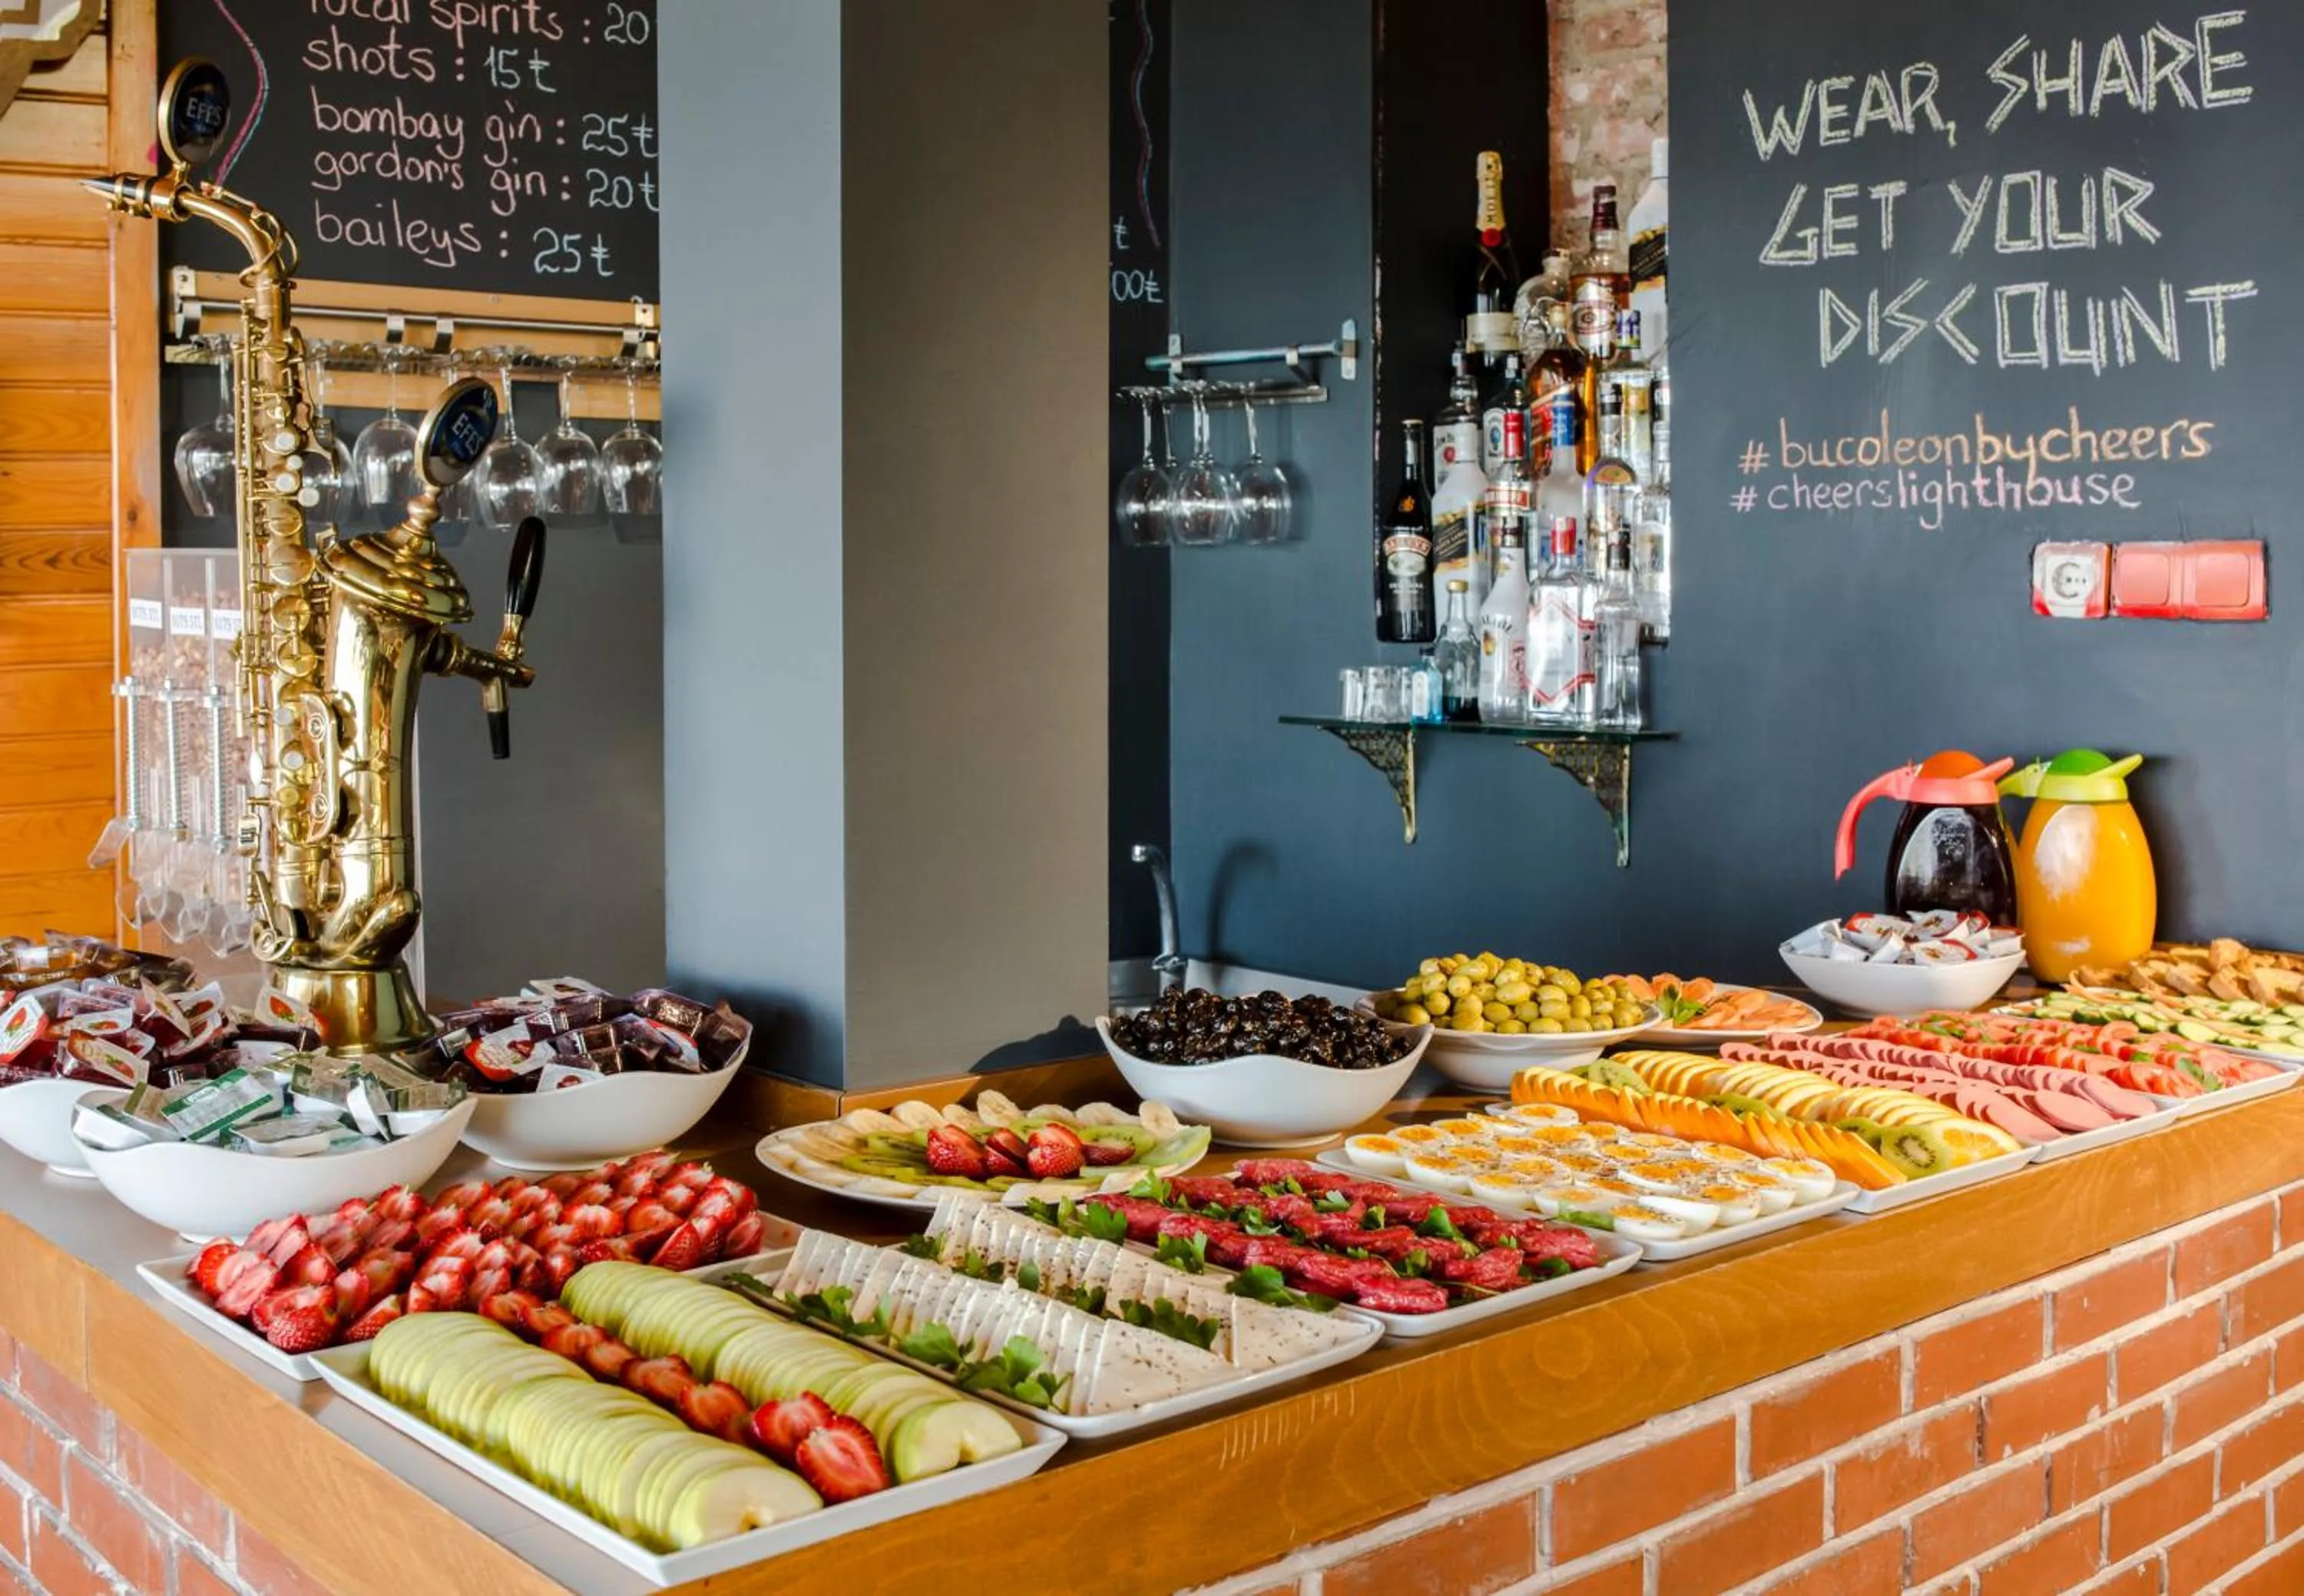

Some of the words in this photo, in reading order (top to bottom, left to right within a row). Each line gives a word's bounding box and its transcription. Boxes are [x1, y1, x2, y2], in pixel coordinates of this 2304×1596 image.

[303, 25, 436, 82] shots
[430, 0, 564, 49] spirits
[1743, 61, 1956, 161] WEAR,
[1987, 10, 2253, 132] SHARE
[311, 86, 465, 161] bombay
[483, 99, 541, 167] gin
[311, 139, 465, 190] gordon's
[491, 157, 548, 217] gin
[1759, 181, 1906, 266] GET
[1948, 167, 2161, 257] YOUR
[315, 198, 482, 268] baileys
[1819, 279, 2258, 376] DISCOUNT
